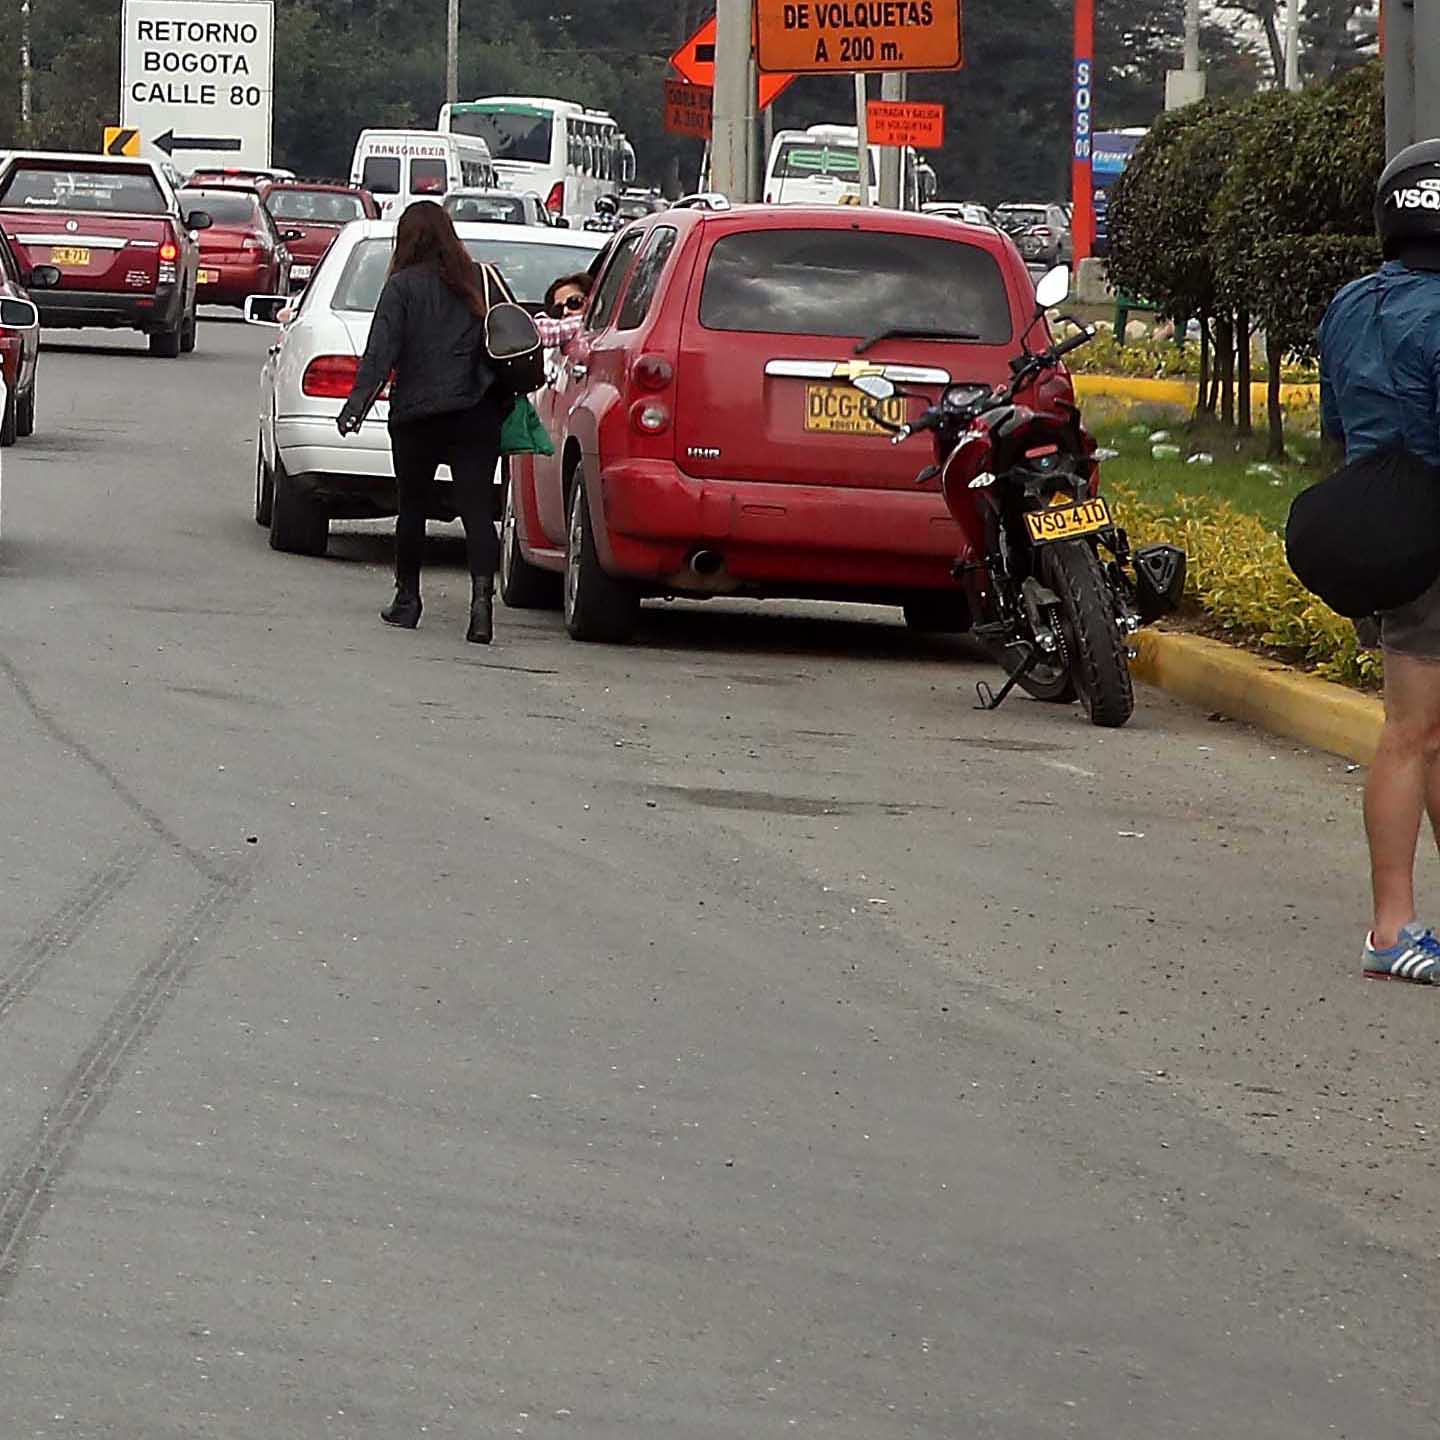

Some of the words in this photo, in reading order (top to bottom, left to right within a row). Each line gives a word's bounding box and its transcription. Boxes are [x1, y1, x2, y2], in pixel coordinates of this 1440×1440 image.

[784, 4, 809, 29] DE
[815, 1, 933, 28] VOLQUETAS
[138, 20, 258, 44] RETORNO
[815, 37, 828, 63] A
[839, 36, 875, 62] 200
[144, 51, 249, 75] BOGOTA
[131, 82, 216, 105] CALLE
[229, 85, 261, 106] 80
[1076, 62, 1090, 135] SOS
[368, 144, 446, 157] TRANSGALAXIA
